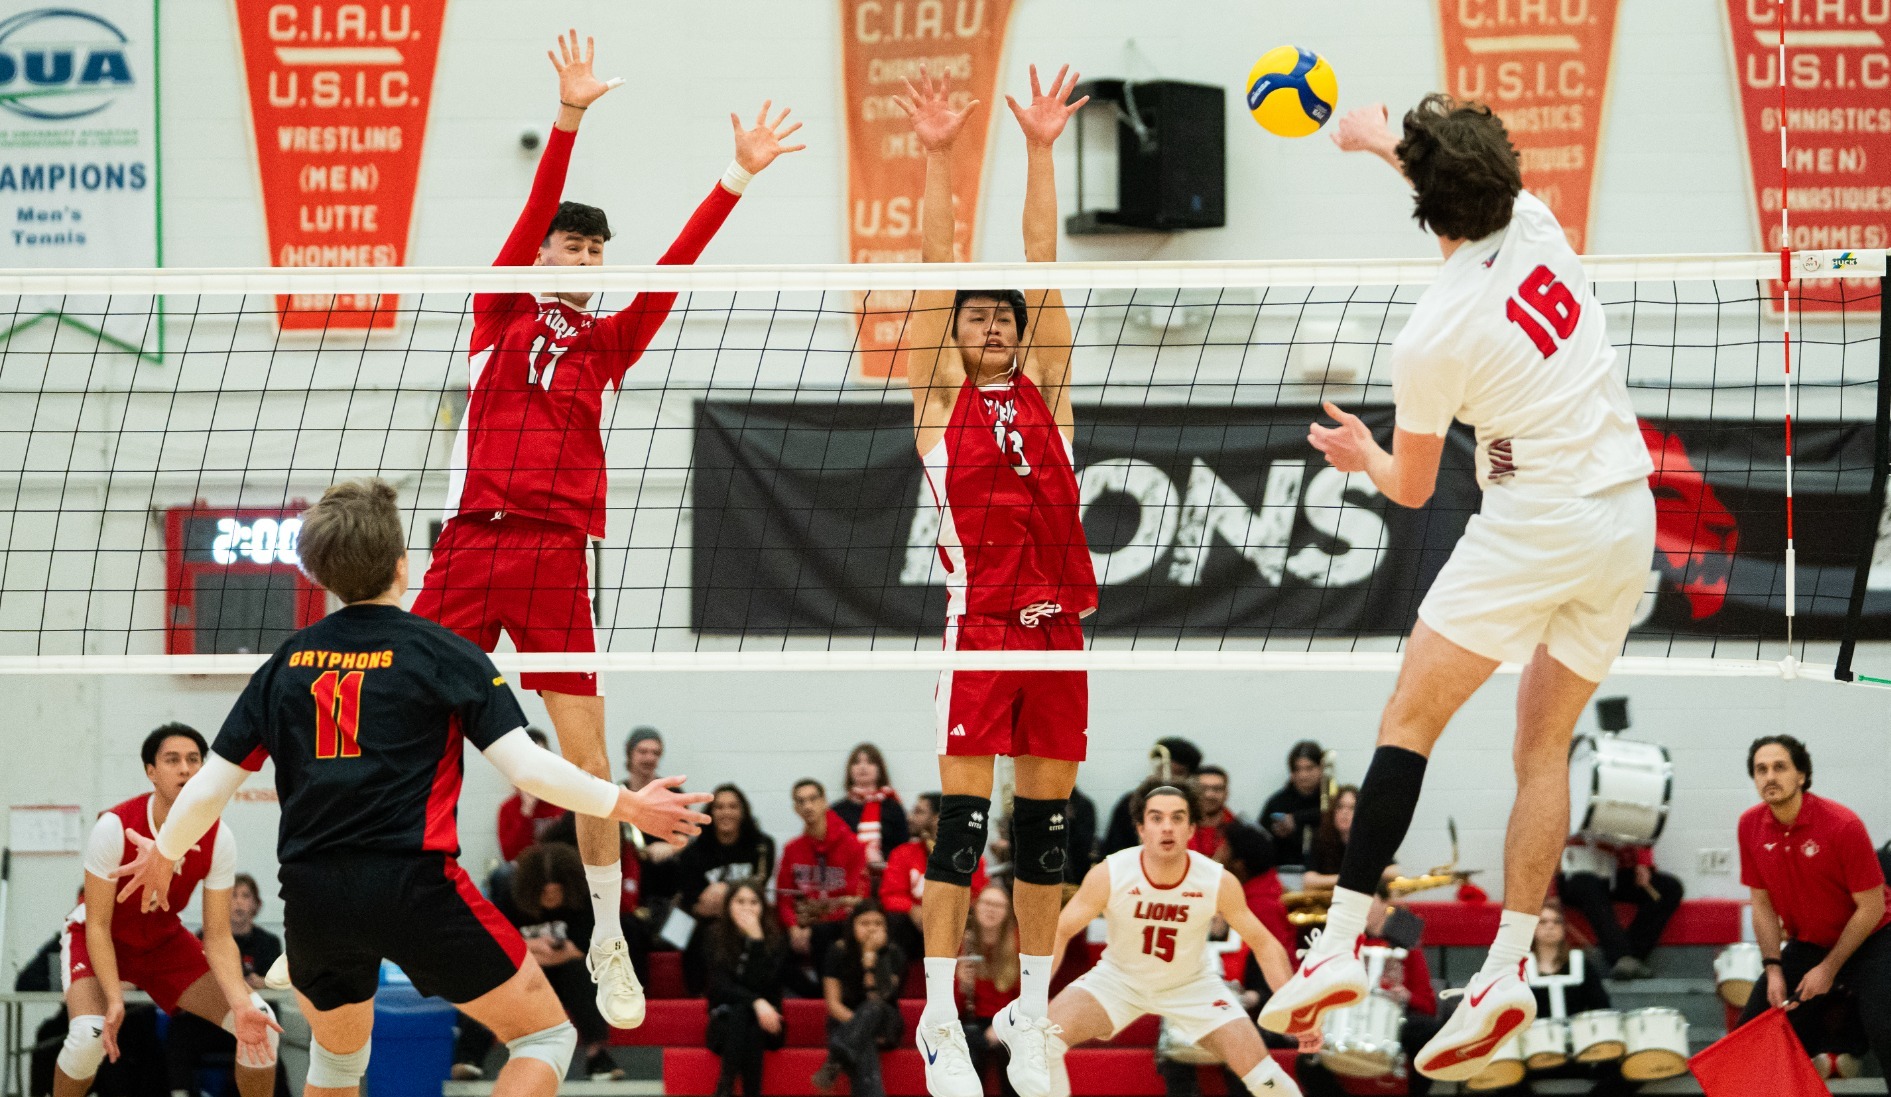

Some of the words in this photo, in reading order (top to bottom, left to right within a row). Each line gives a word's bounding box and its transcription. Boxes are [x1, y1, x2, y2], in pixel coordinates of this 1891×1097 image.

[267, 4, 422, 41] C.I.A.U.
[855, 0, 991, 44] C.I.A.U.
[267, 70, 421, 107] U.S.I.C.
[1456, 60, 1596, 100] U.S.I.C.
[277, 126, 402, 152] WRESTLING
[299, 164, 379, 192] (MEN)
[1786, 145, 1867, 174] (MEN)
[17, 205, 82, 222] Men's
[301, 205, 378, 231] LUTTE
[13, 229, 86, 246] Tennis
[280, 243, 397, 267] (HOMMES)
[1505, 264, 1581, 359] 16
[526, 333, 569, 393] 17
[993, 420, 1032, 477] 13
[212, 517, 304, 565] 2:00
[899, 457, 1391, 588] LONS
[288, 649, 394, 670] GRYPHONS
[310, 669, 365, 760] 11
[1133, 900, 1190, 923] LIONS
[1141, 925, 1179, 963] 15
